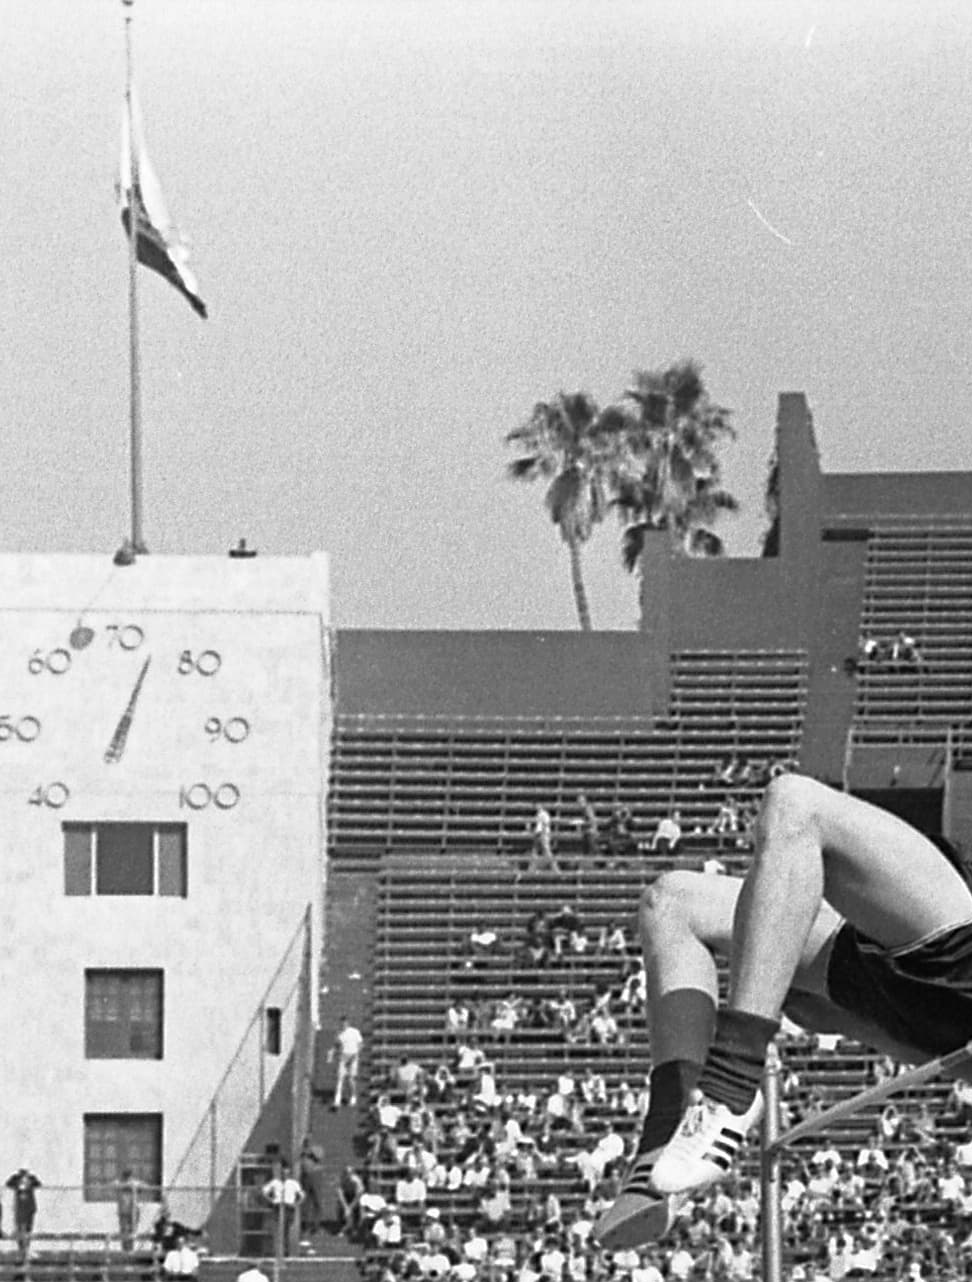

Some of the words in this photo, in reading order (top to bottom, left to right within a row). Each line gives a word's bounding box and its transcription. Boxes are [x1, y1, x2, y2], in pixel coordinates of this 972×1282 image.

[106, 625, 144, 650] 70
[28, 648, 72, 674] 60
[178, 650, 222, 676] 80
[0, 715, 42, 742] 50
[204, 717, 250, 743] 90
[28, 782, 70, 809] 40
[179, 783, 241, 810] 100
